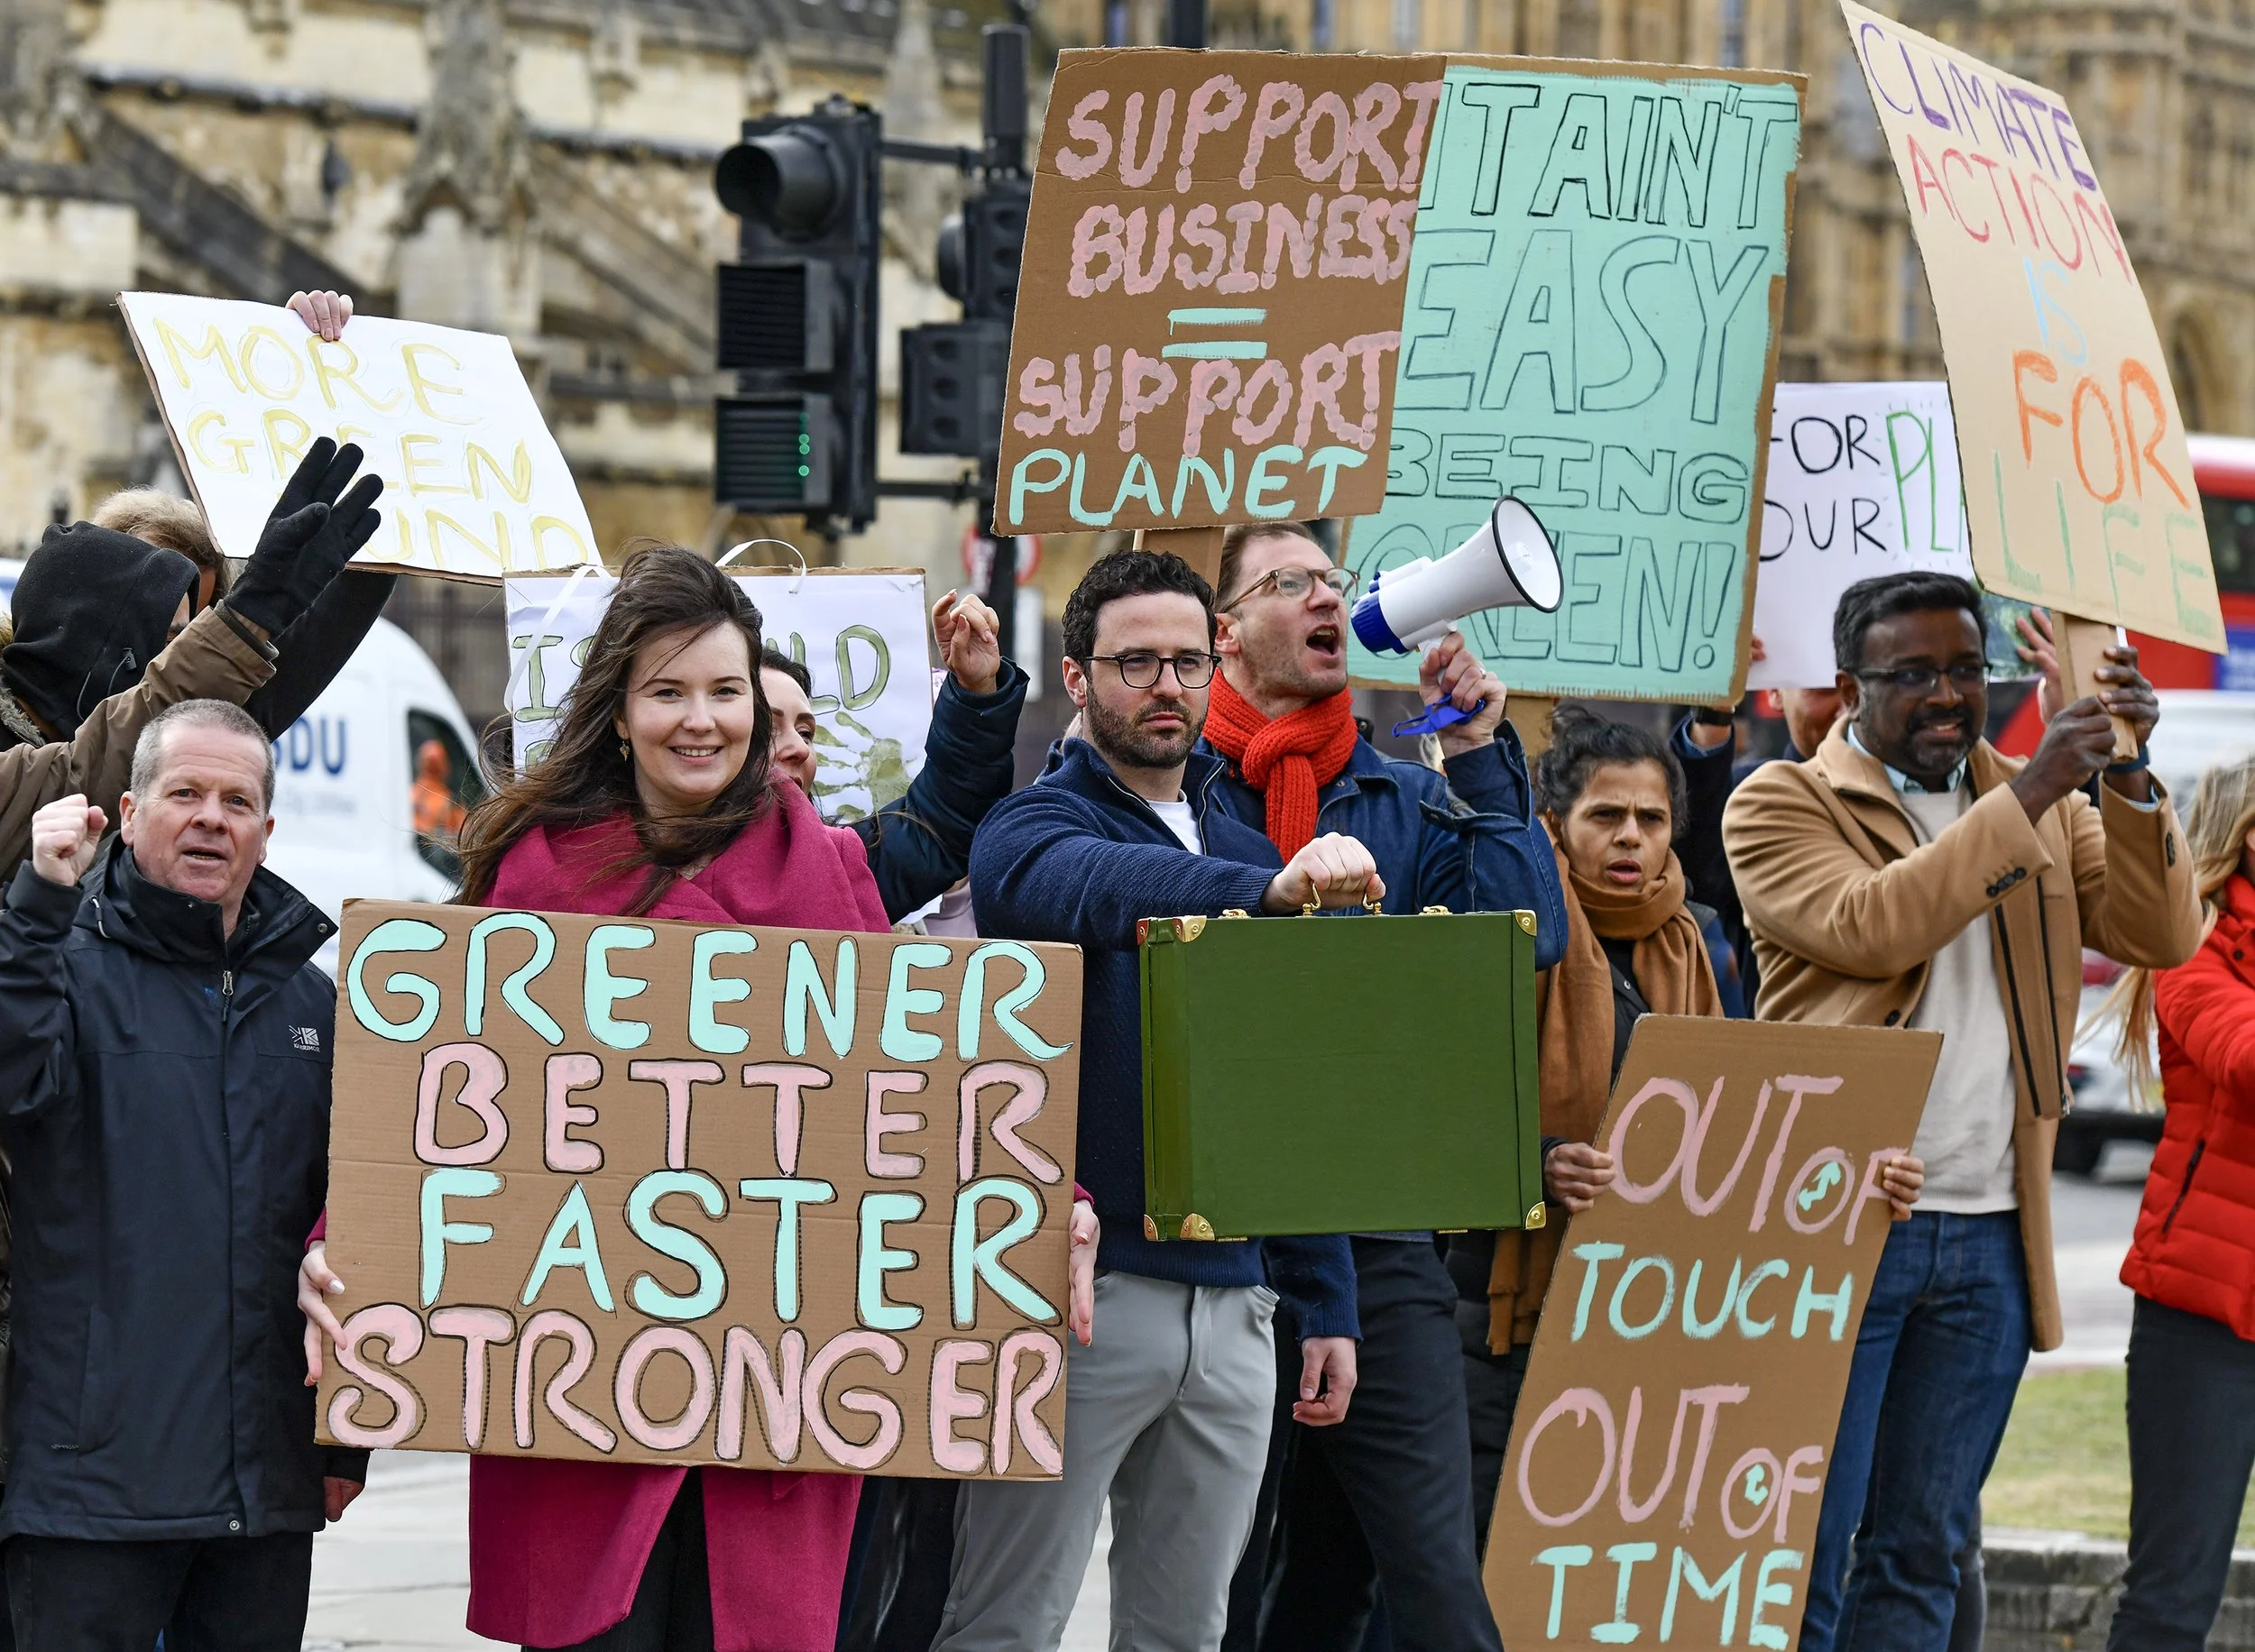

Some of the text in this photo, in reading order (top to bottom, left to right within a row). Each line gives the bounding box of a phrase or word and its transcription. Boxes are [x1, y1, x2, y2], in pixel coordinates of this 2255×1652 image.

[1055, 73, 1443, 194] SUPPORT
[1527, 86, 1798, 229] AIN'T
[1860, 23, 2097, 192] CLIMATE
[1067, 192, 1420, 298] BUSINESS
[1907, 133, 2133, 286] ACTION
[152, 316, 483, 425] MORE
[1394, 228, 1769, 426] EASY
[2023, 255, 2088, 366] IS
[1014, 330, 1403, 458] SUPPORT
[2012, 348, 2192, 510] FOR
[361, 505, 588, 571] UND
[1008, 445, 1368, 526] PLANET
[1385, 427, 1748, 525] BEING
[1759, 498, 1888, 562] OUR
[1885, 410, 1965, 553] PL
[1993, 447, 2219, 639] LIFE
[345, 910, 1073, 1065] GREENER
[413, 1042, 1064, 1186] BETTER
[1607, 1073, 1910, 1245] OUT OF
[418, 1167, 1063, 1332] FASTER
[1570, 1240, 1855, 1342] TOUCH
[327, 1301, 1065, 1477] STRONGER
[1518, 1384, 1825, 1544] OUT OF
[1531, 1541, 1804, 1648] TIME
